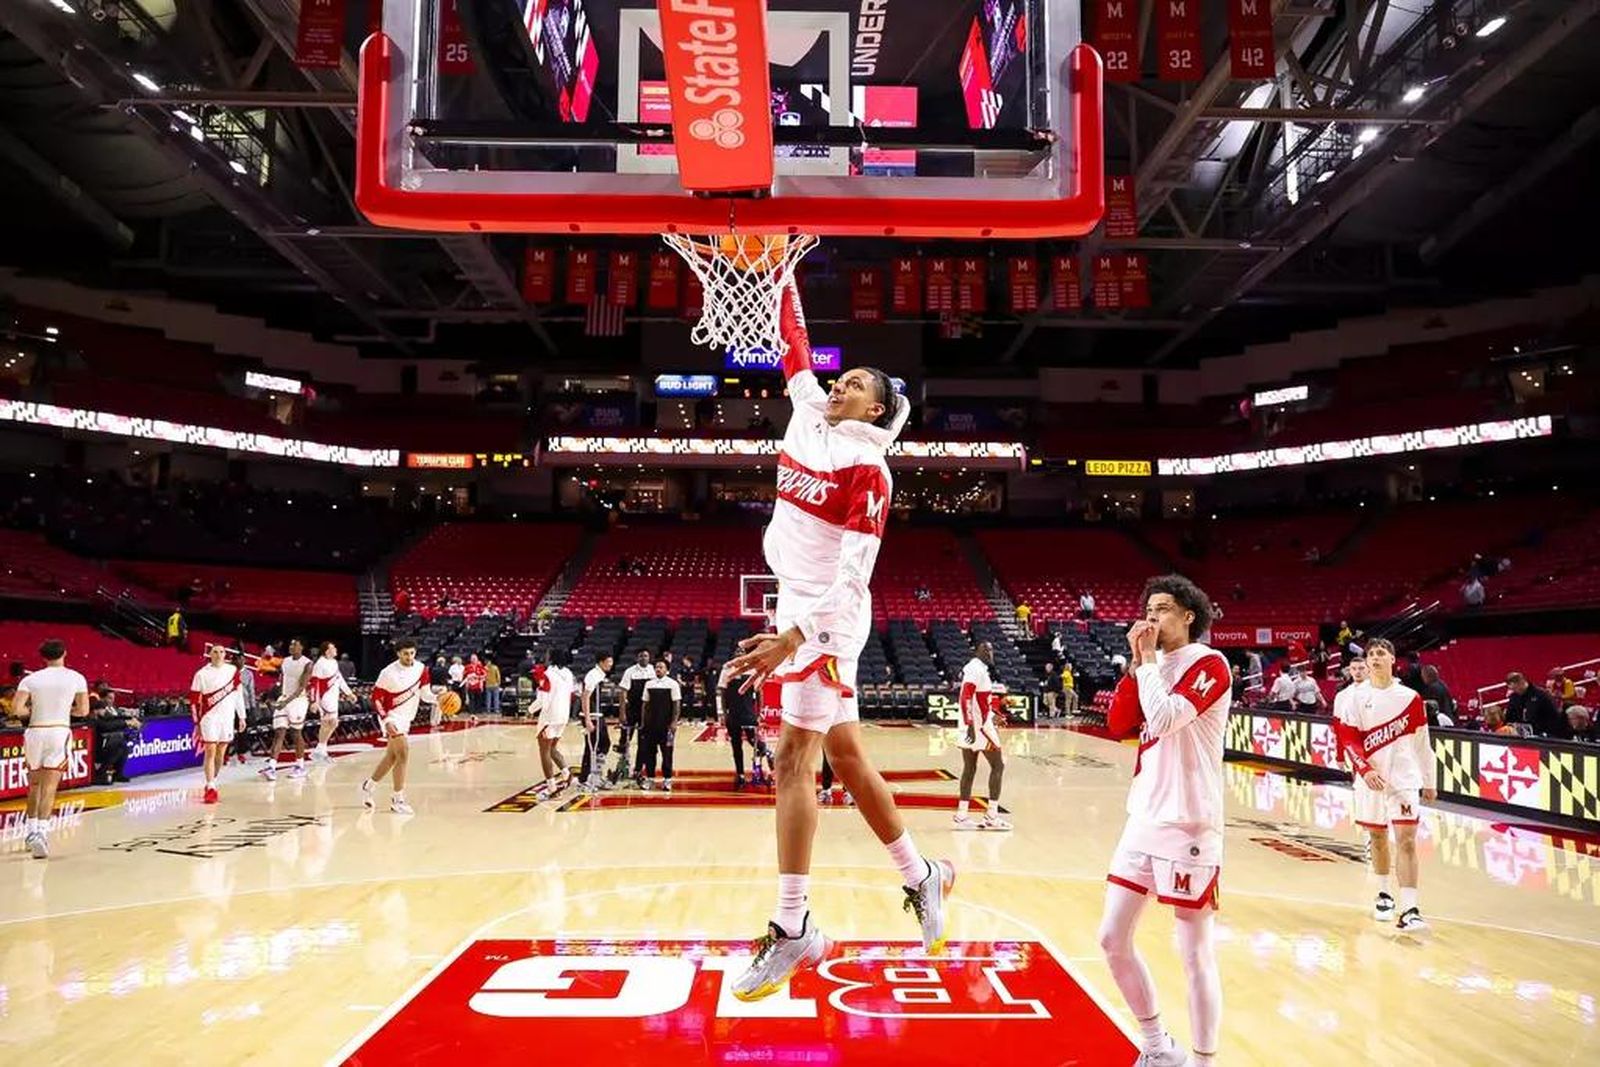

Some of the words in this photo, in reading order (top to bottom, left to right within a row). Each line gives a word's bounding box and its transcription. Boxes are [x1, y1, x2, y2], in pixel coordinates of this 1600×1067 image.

[851, 0, 888, 76] UNDER
[445, 44, 467, 62] 25
[1106, 51, 1128, 70] 22
[1169, 50, 1192, 68] 32
[1241, 48, 1264, 67] 42
[659, 381, 681, 390] BUD
[683, 381, 714, 390] LIGHT
[1087, 462, 1115, 474] LEDO
[1117, 462, 1150, 474] PIZZA
[866, 491, 885, 522] M
[1213, 632, 1248, 640] TOYOTA
[1275, 631, 1312, 640] TOYOTA
[1191, 669, 1217, 698] M
[1401, 804, 1412, 816] M
[1174, 872, 1191, 891] M
